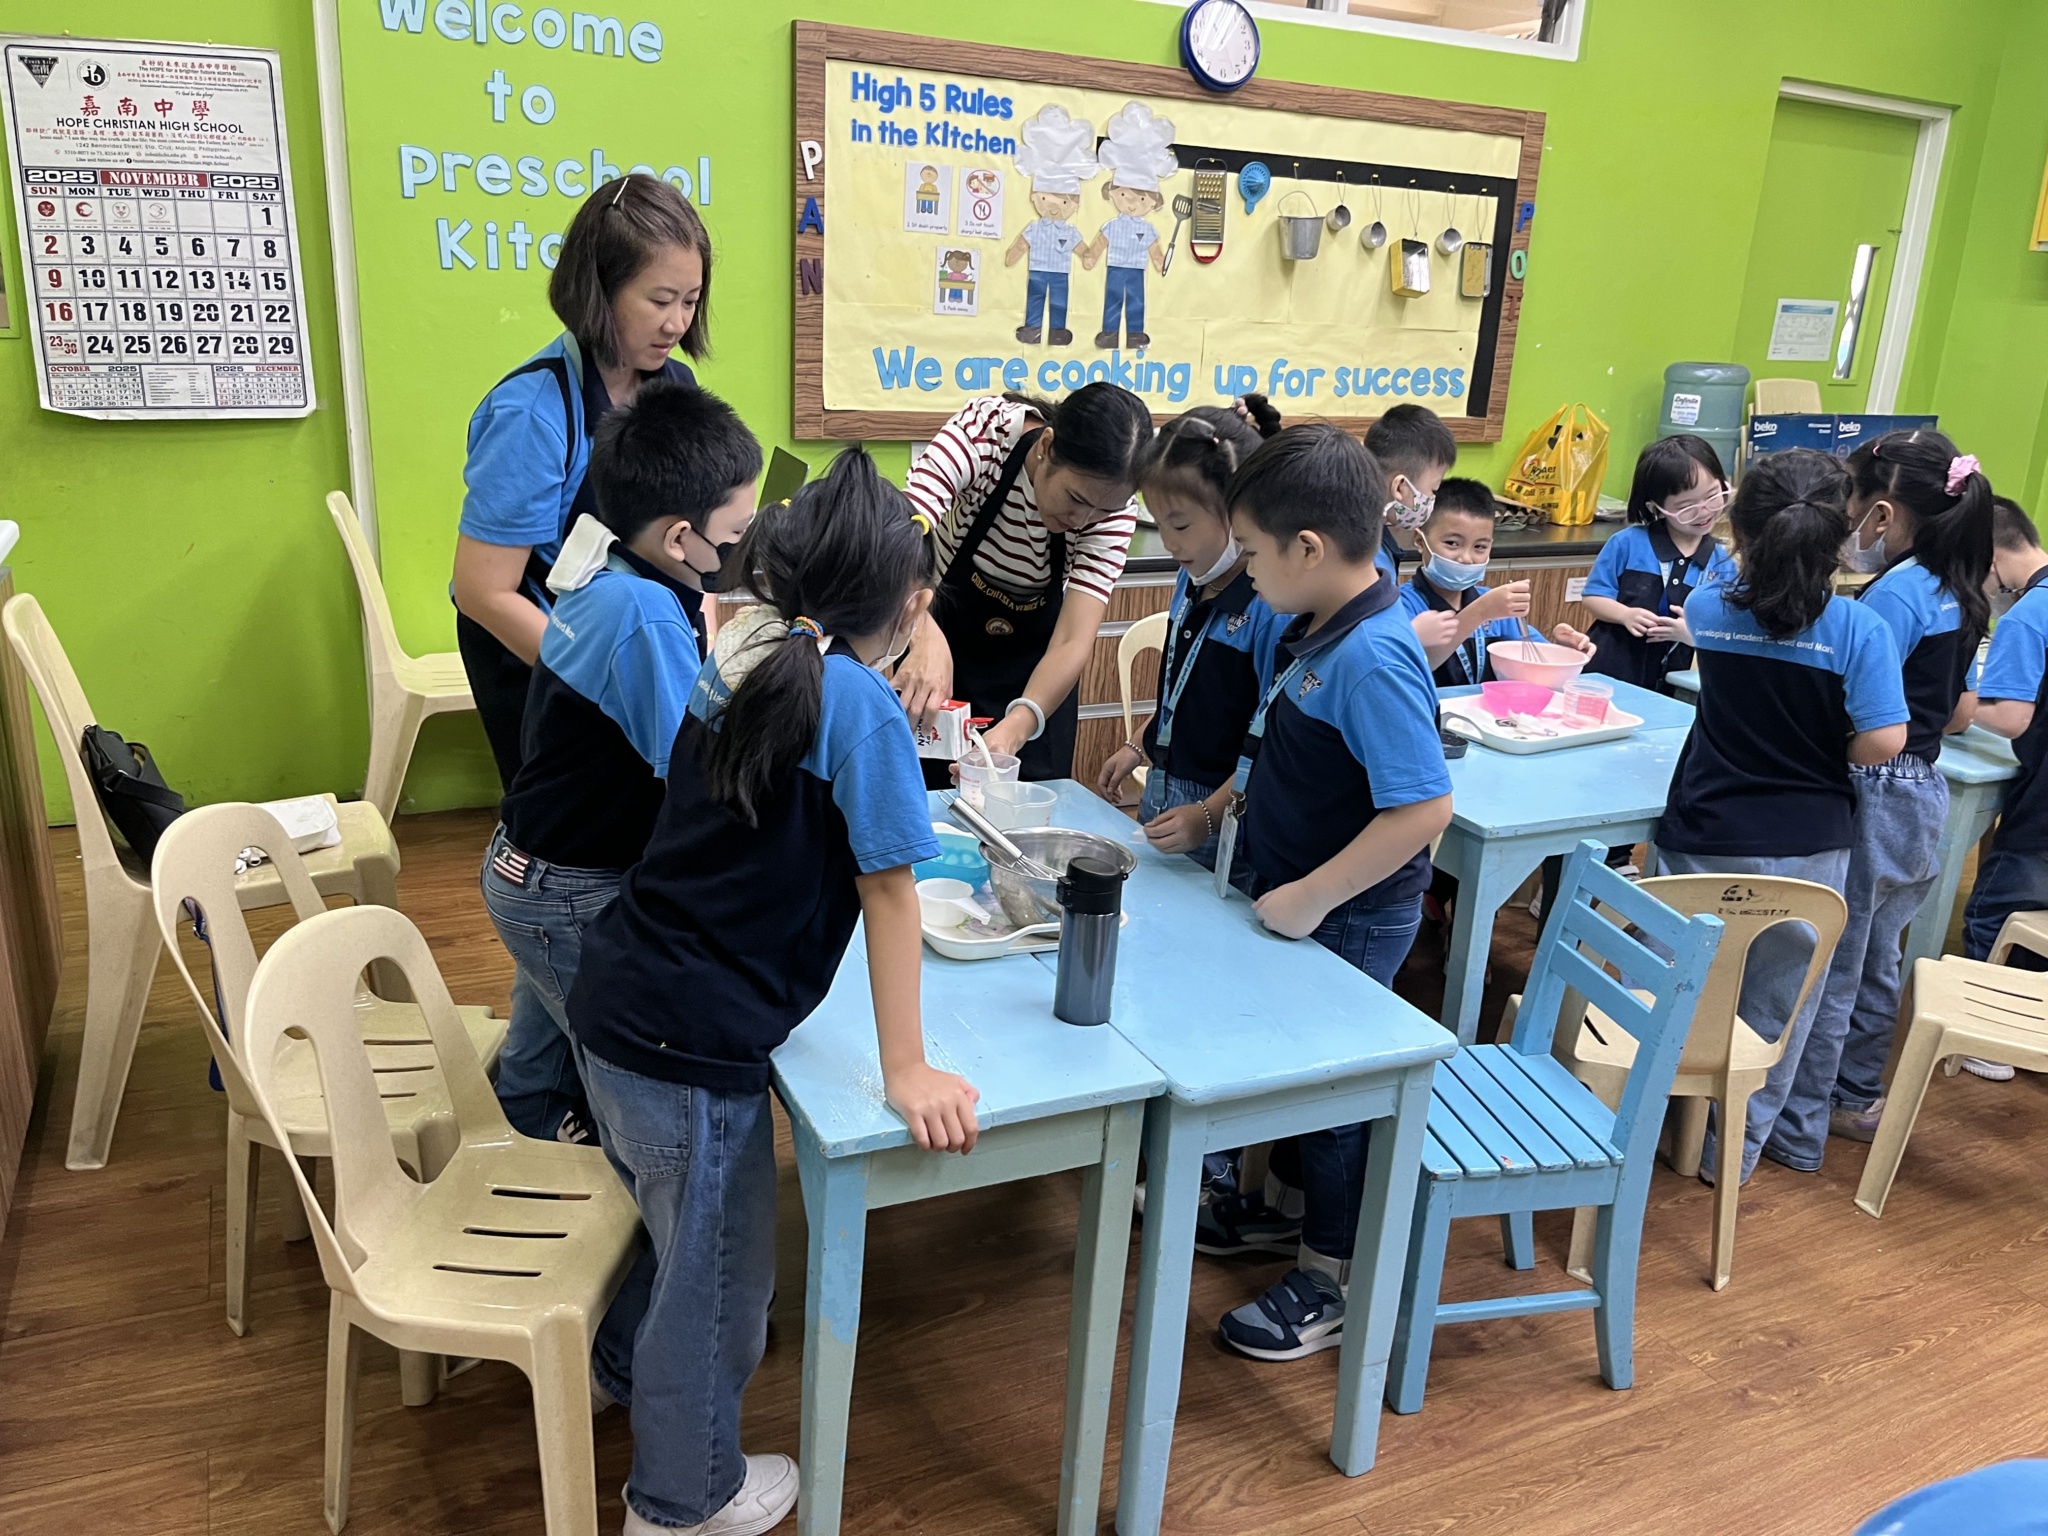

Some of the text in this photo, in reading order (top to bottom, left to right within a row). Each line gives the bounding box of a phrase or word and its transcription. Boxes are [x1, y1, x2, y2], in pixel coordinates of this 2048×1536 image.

[380, 0, 663, 63] Welcome
[486, 69, 556, 125] to
[851, 71, 1014, 120] High 5 Rules
[80, 95, 210, 121] 嘉南中學
[56, 118, 90, 128] HOPE
[93, 119, 156, 130] CHRISTIAN
[160, 121, 190, 131] HIGH
[194, 122, 244, 134] SCHOOL
[851, 118, 1016, 155] in the Kitchen
[27, 170, 277, 189] 2025 NOVEMBER 2025
[31, 186, 276, 201] SUN MON TUE WED THU FRI SAT
[262, 207, 272, 226] 1
[44, 235, 277, 258] 2 3 4 5 6 7 8
[436, 218, 568, 272] Kitc
[48, 268, 286, 291] 9 10 11 12 13 14 15
[46, 302, 292, 323] 16 17 18 19 20 21 22
[50, 336, 294, 354] 23 30 24 25 26 27 28 29
[872, 345, 1466, 403] We are cooking up for success
[1754, 422, 1778, 432] beko
[1839, 422, 1862, 432] beko
[1732, 632, 1764, 643] Leaders
[1796, 640, 1814, 650] and
[1814, 642, 1834, 654] Man.
